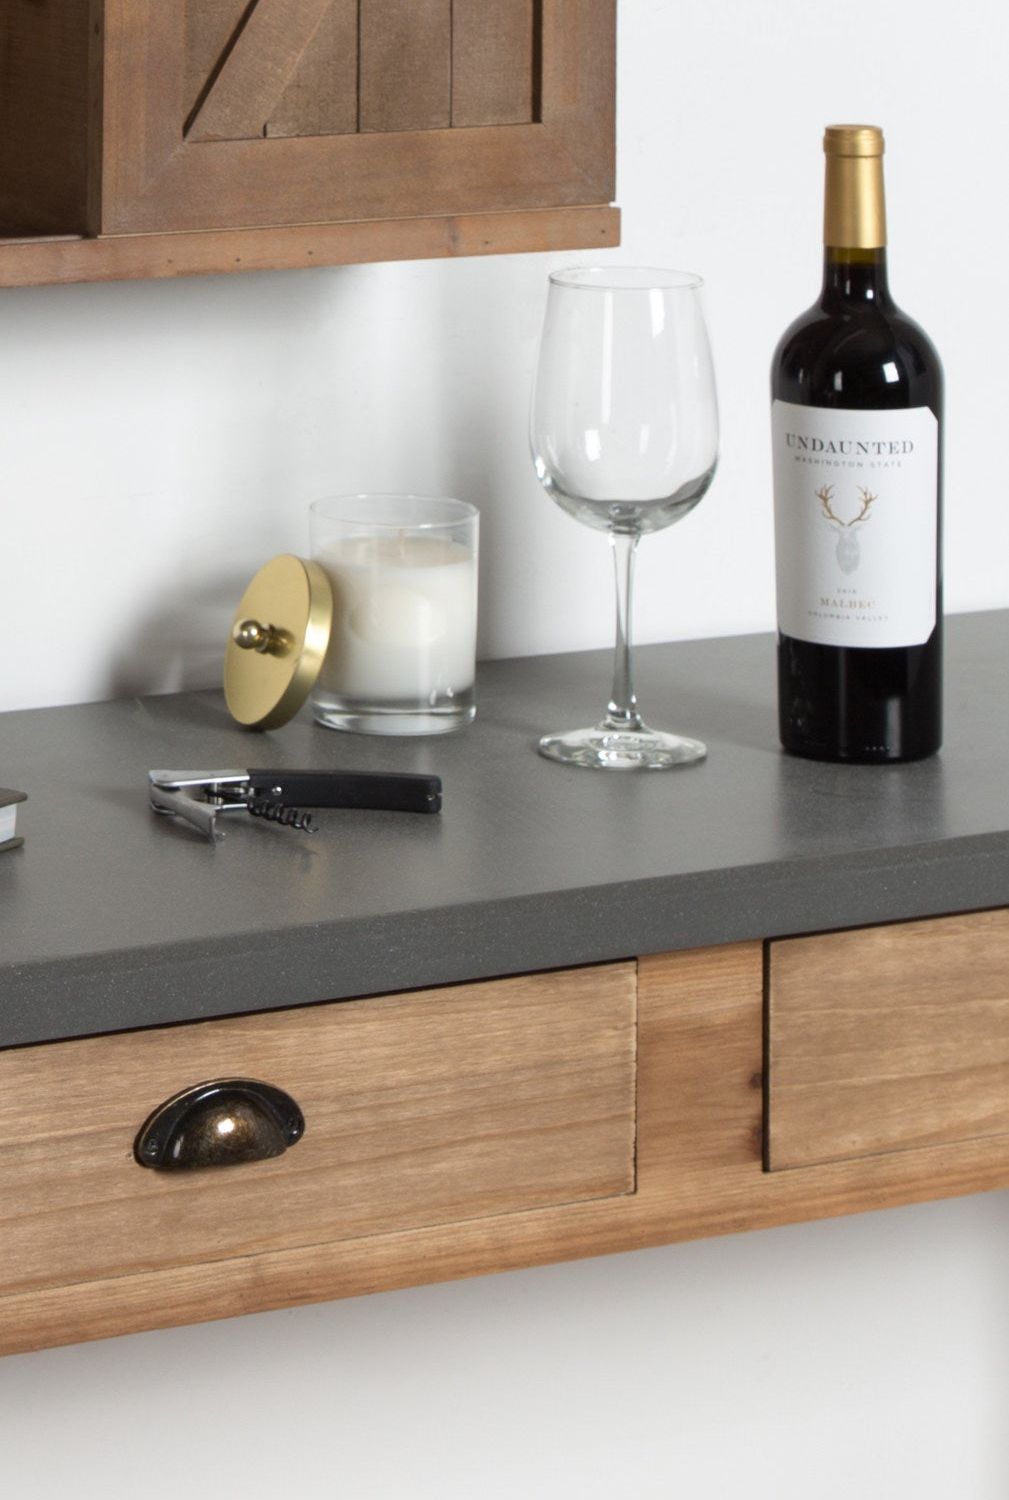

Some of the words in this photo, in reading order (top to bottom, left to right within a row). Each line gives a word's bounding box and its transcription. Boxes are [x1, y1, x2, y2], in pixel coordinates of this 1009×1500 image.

[785, 433, 914, 455] UNDAUNTED
[794, 456, 863, 468] WASHINGTON
[820, 597, 876, 609] MALBEC
